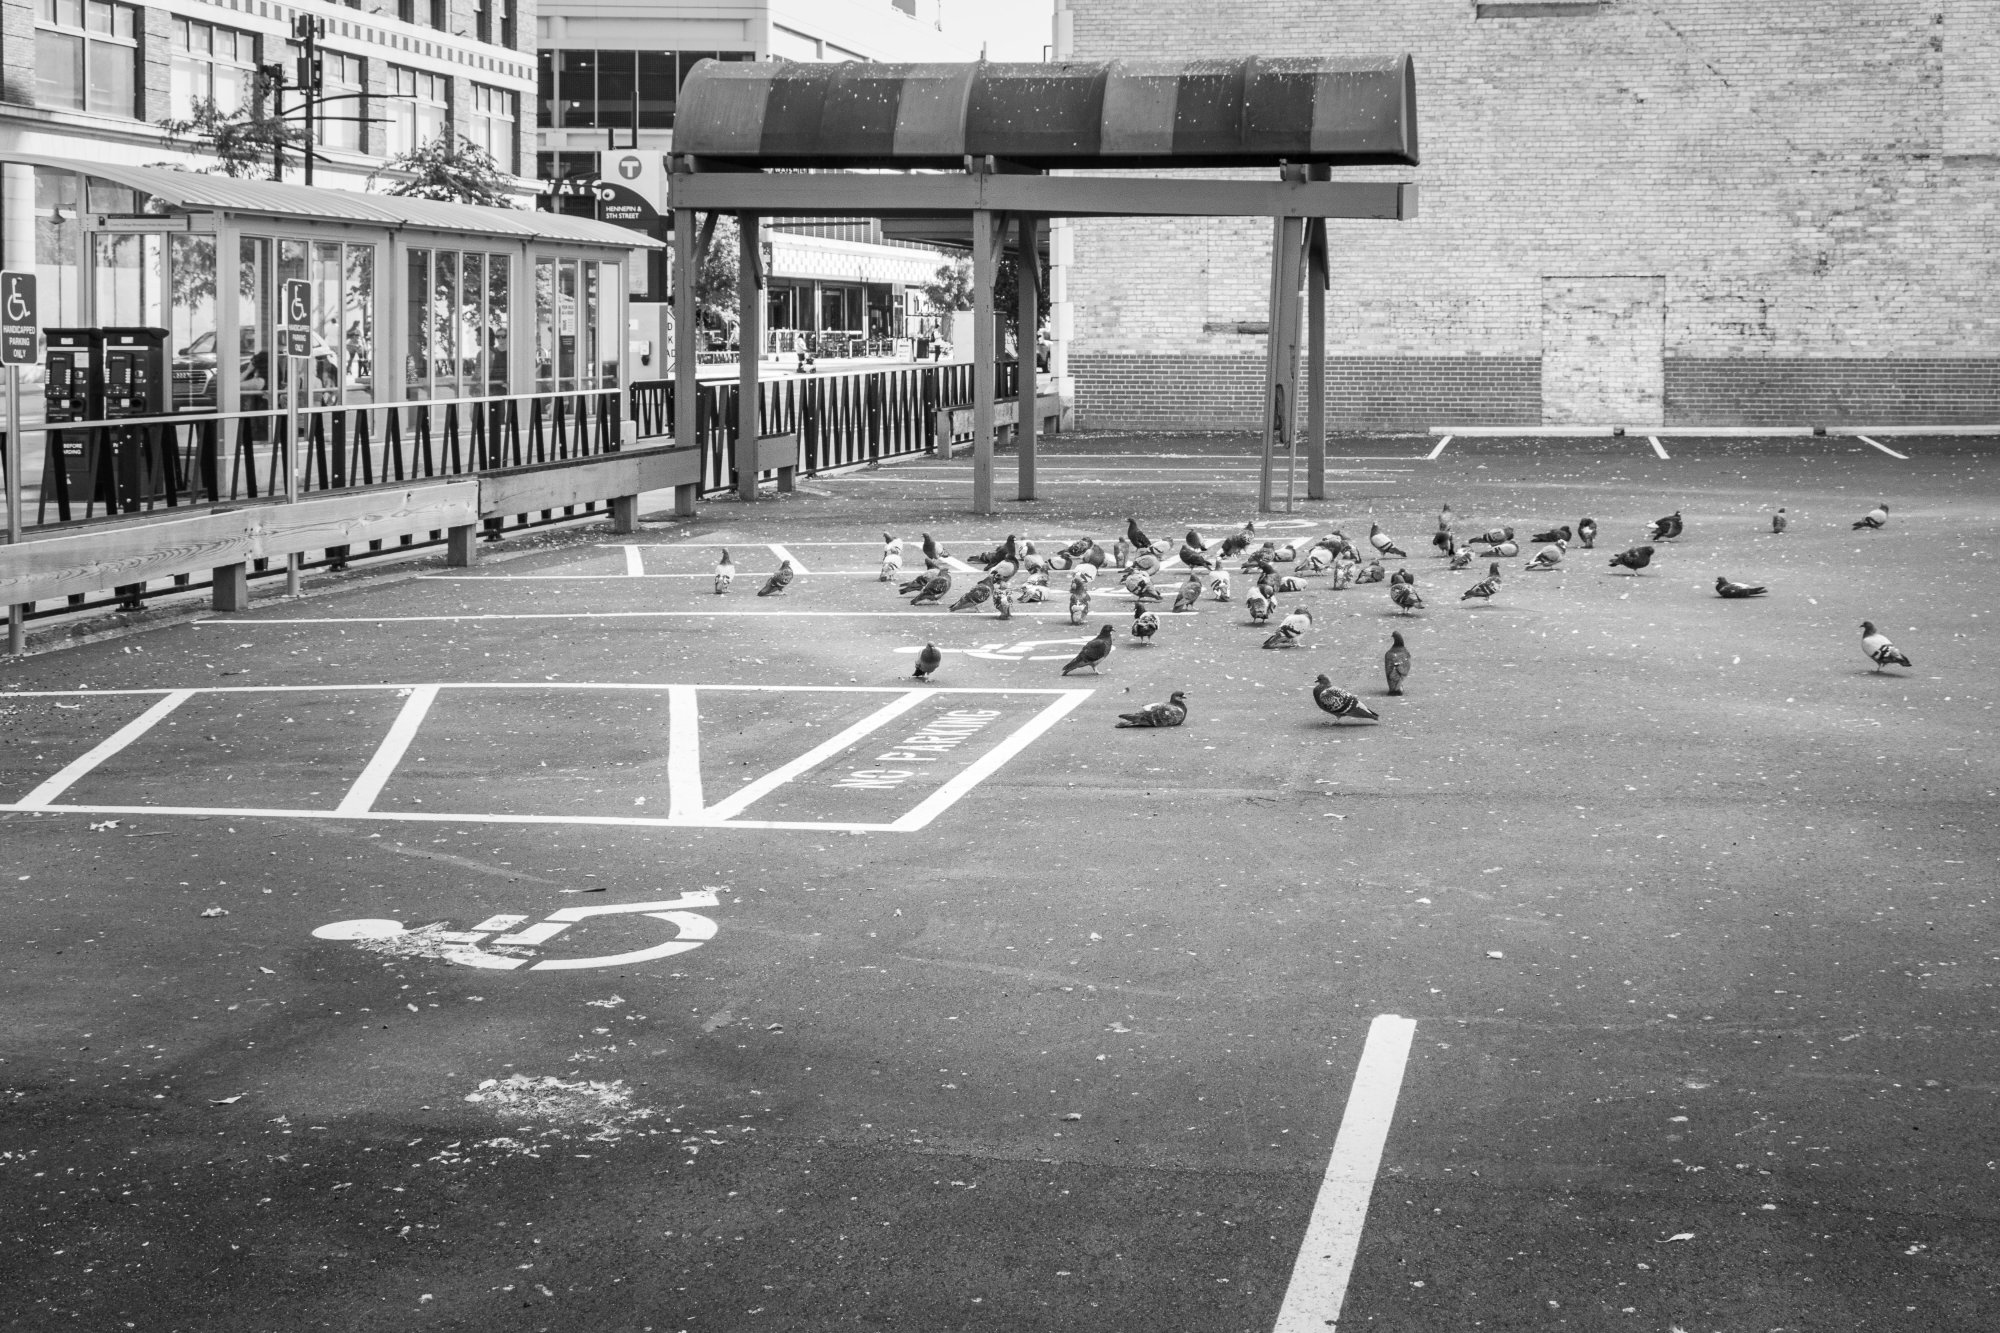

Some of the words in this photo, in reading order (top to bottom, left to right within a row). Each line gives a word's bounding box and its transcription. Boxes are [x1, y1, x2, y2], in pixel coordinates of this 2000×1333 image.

[621, 160, 639, 178] T
[3, 325, 35, 334] HANDICAPPED
[289, 324, 310, 332] HANDICAPPED
[9, 337, 30, 346] PARKING
[292, 333, 306, 341] PARKING
[295, 344, 303, 352] ONLY
[13, 349, 26, 358] ONLY
[831, 769, 914, 788] NO
[875, 710, 1001, 761] PARKING
